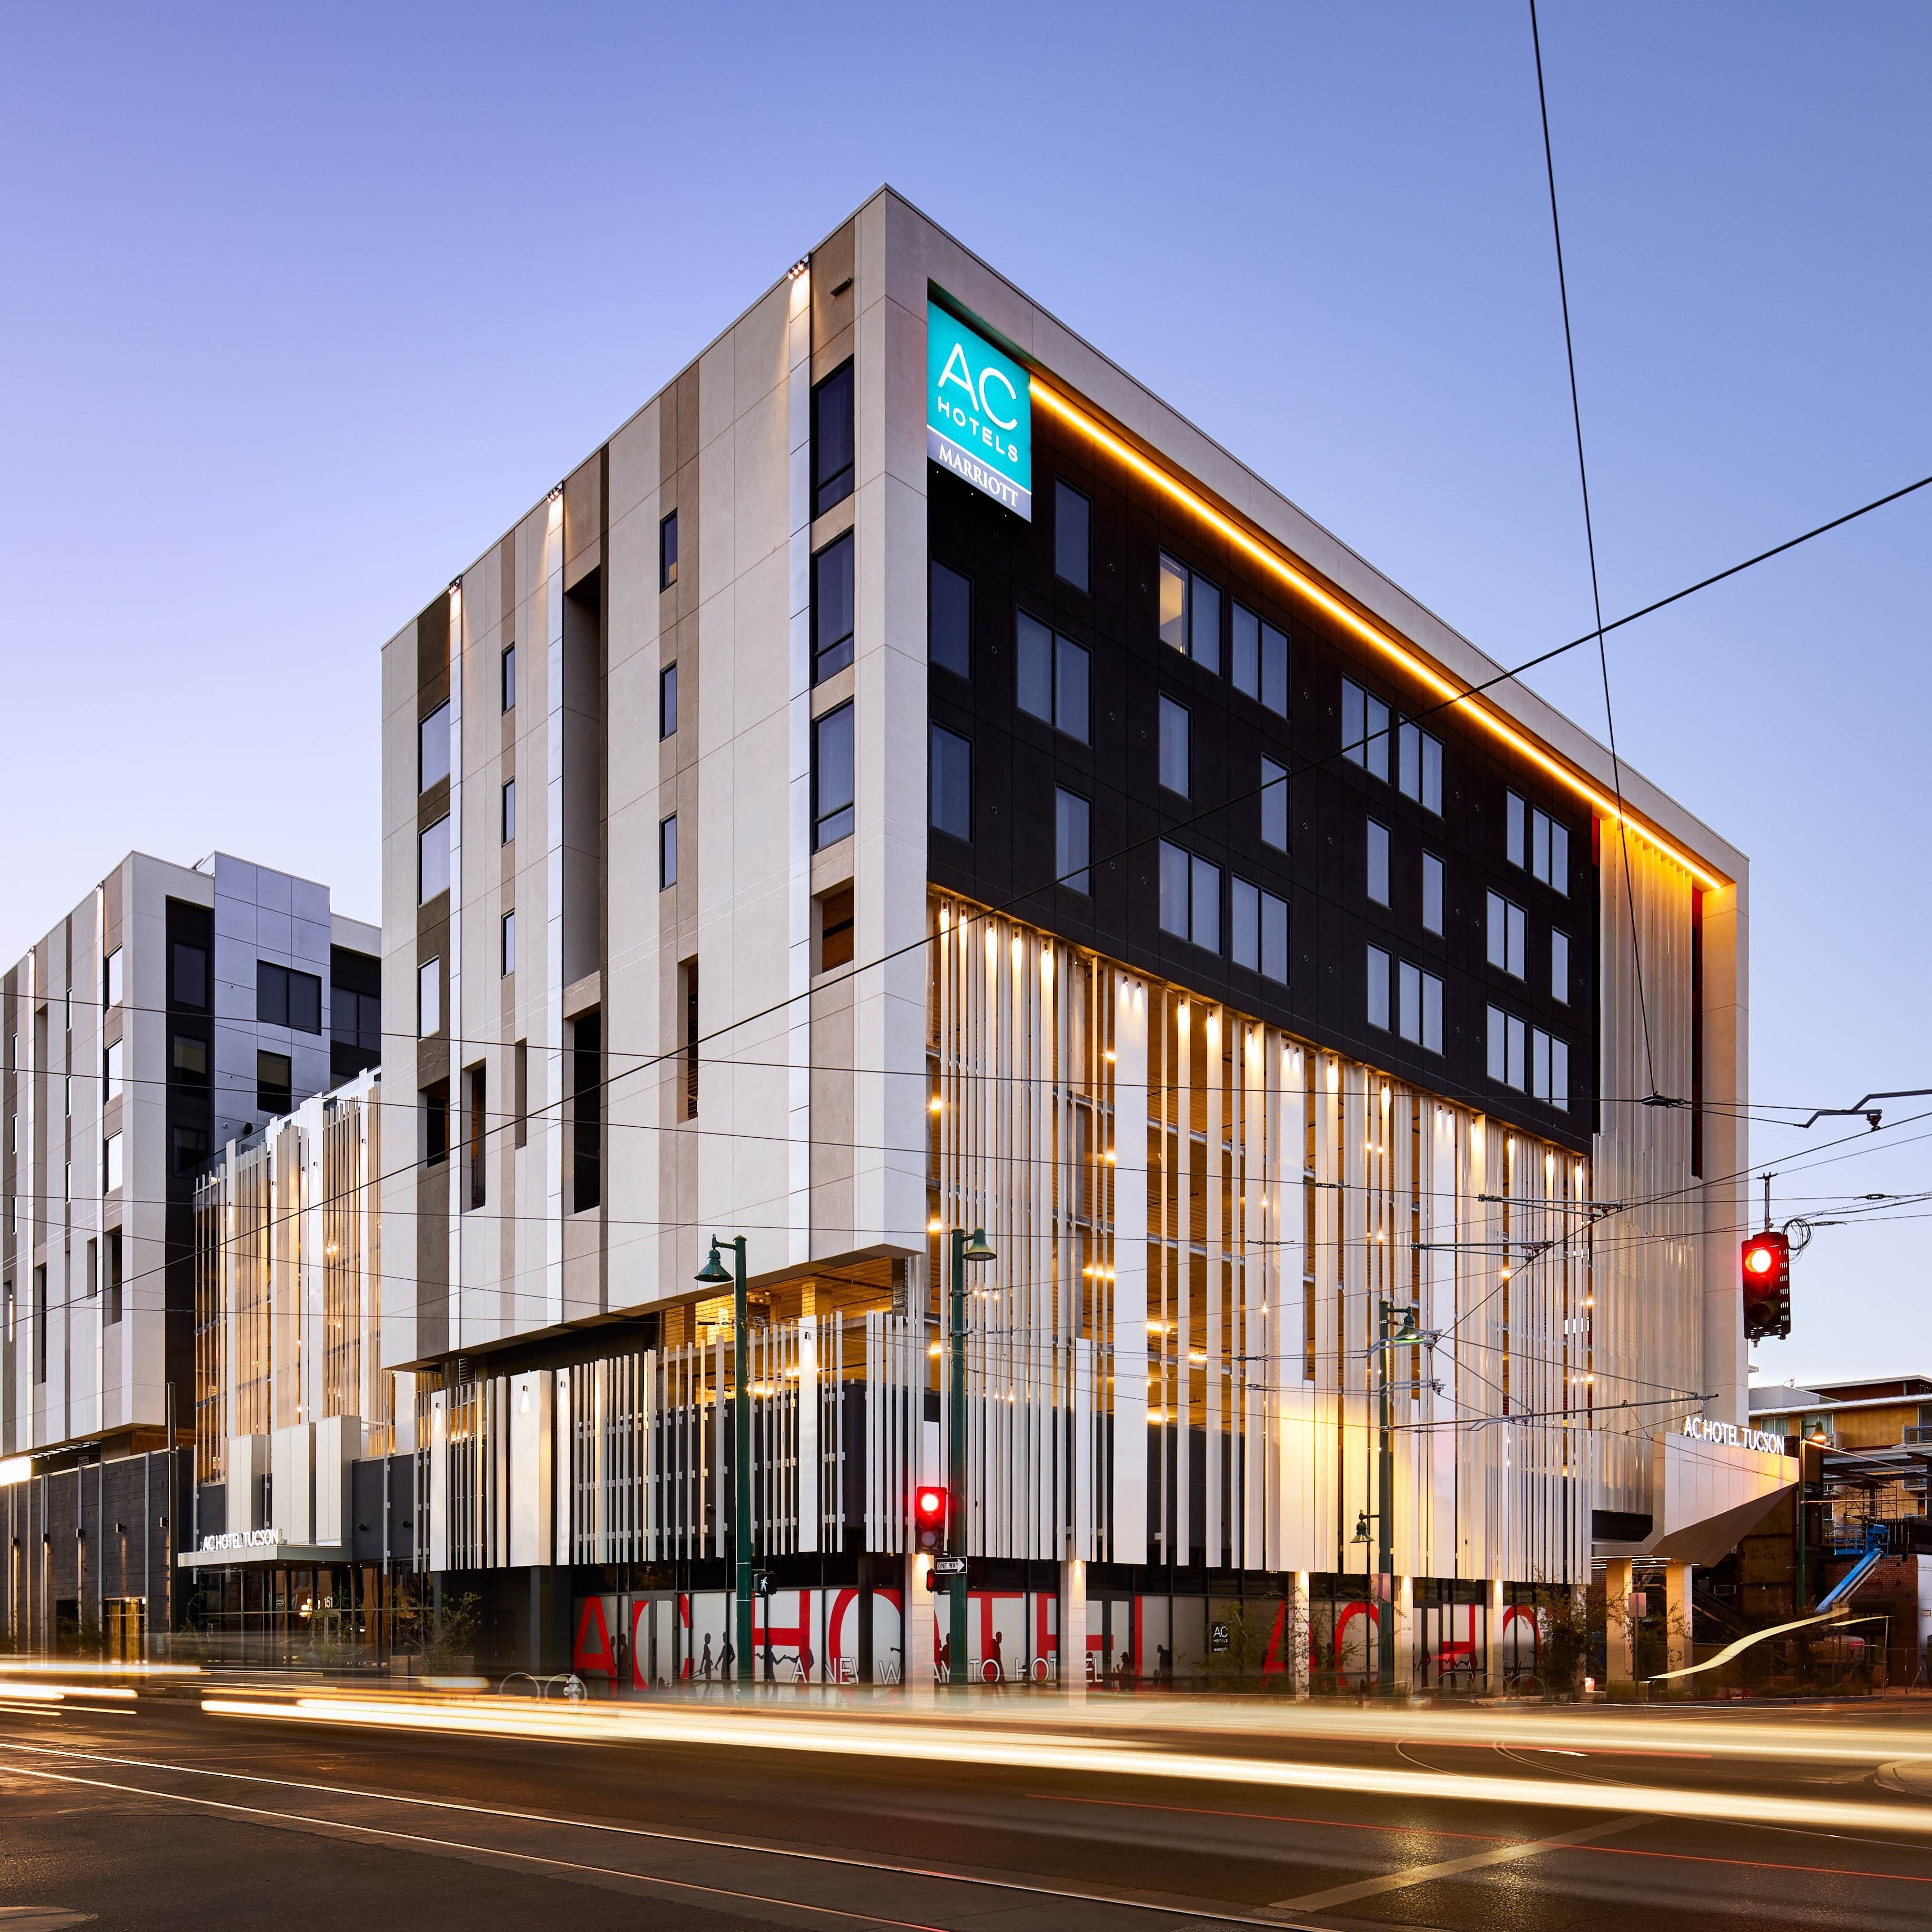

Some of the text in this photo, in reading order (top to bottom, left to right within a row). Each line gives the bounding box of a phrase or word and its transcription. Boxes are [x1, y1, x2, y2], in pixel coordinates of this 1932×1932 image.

[937, 342, 1018, 431] AC
[937, 396, 1019, 463] HOTELS
[938, 442, 1018, 507] MARRIOTT
[1683, 1415, 1785, 1455] AC HOTEL TUCSON
[203, 1528, 279, 1551] AC HOTEL TUCSON
[323, 1596, 333, 1608] 151
[1213, 1626, 1228, 1637] AC
[791, 1657, 807, 1684] A
[969, 1658, 1000, 1683] TO
